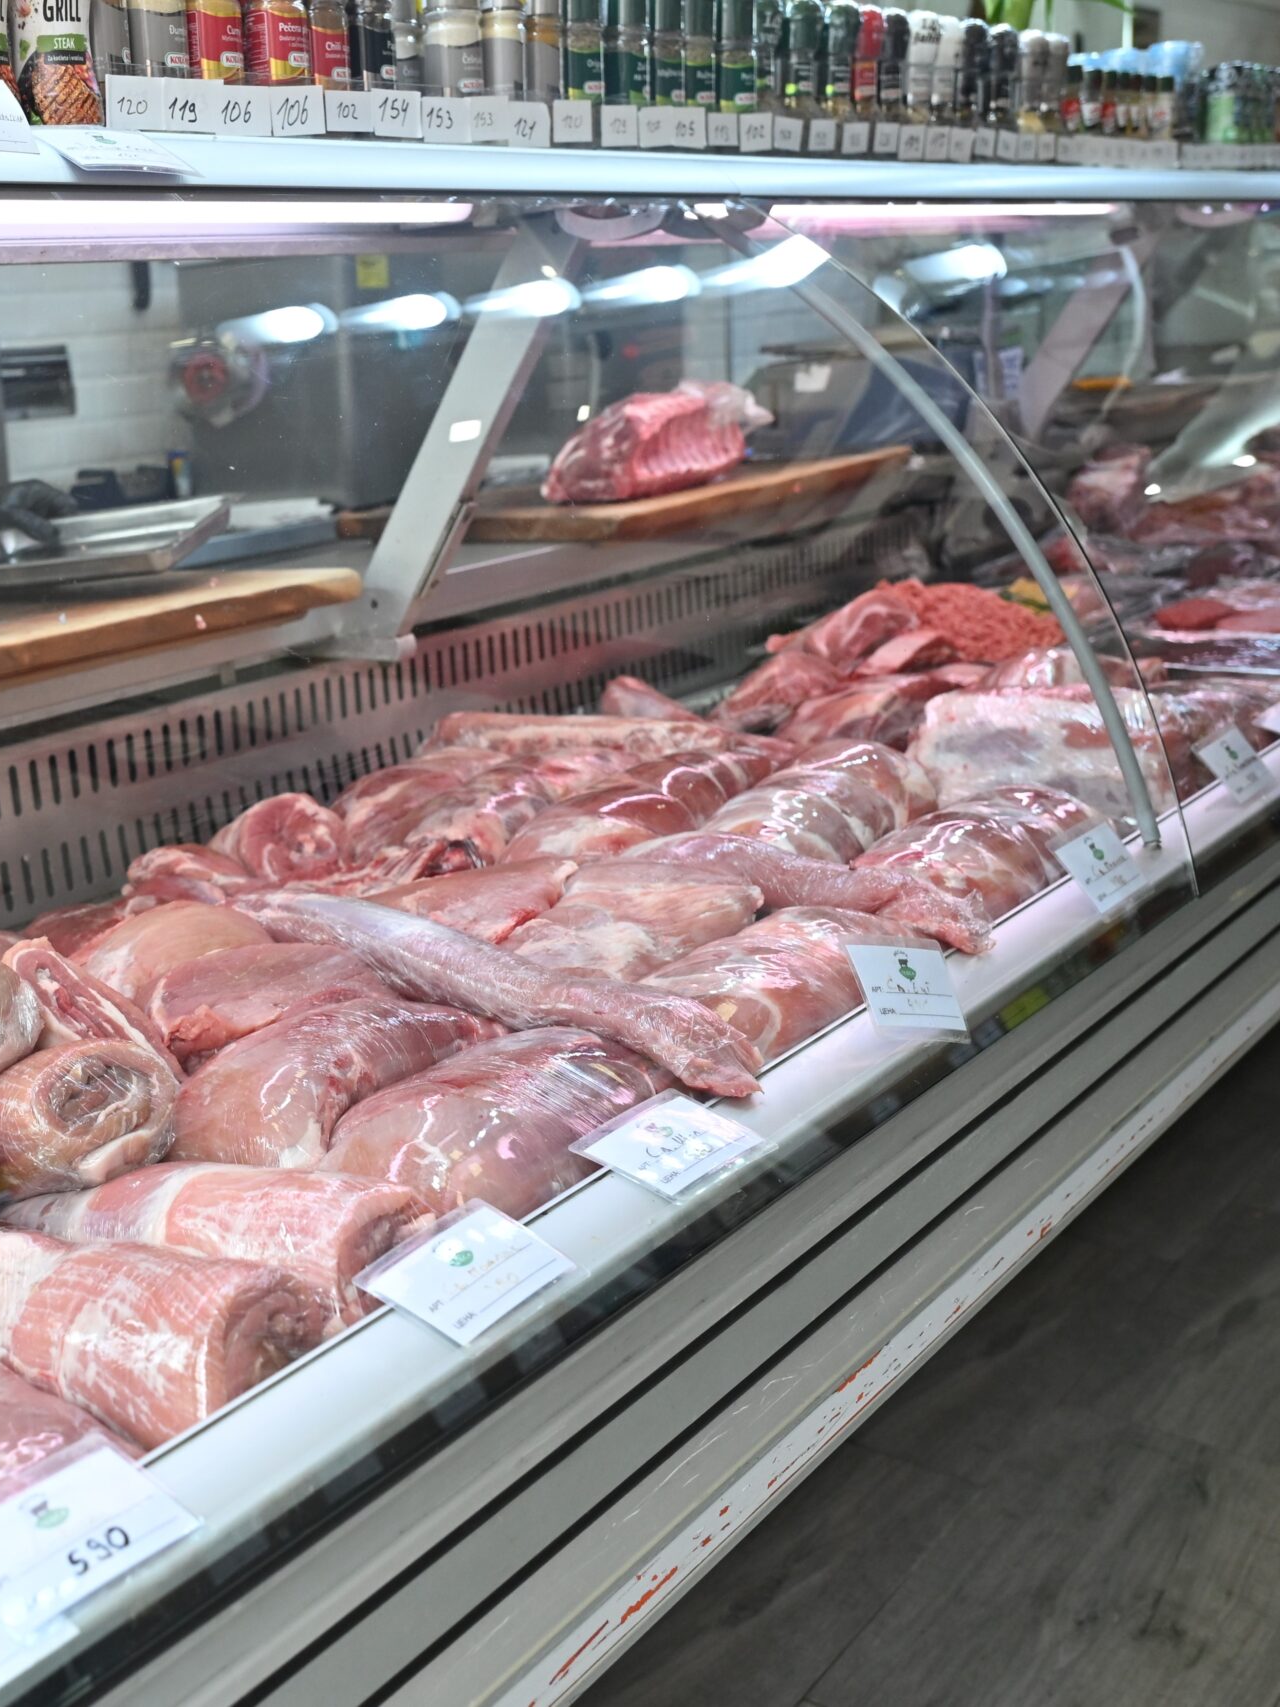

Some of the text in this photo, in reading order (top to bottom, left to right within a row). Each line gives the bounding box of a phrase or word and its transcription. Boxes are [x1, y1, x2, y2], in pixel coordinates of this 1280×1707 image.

[43, 0, 81, 22] GRILL
[53, 37, 76, 49] STEAK
[117, 96, 149, 116] 120
[168, 97, 198, 123] 119
[221, 100, 252, 125] 106
[276, 95, 309, 130] 106
[336, 101, 359, 120] 102
[378, 96, 410, 127] 154
[426, 107, 454, 130] 153
[68, 1526, 131, 1576] 590
